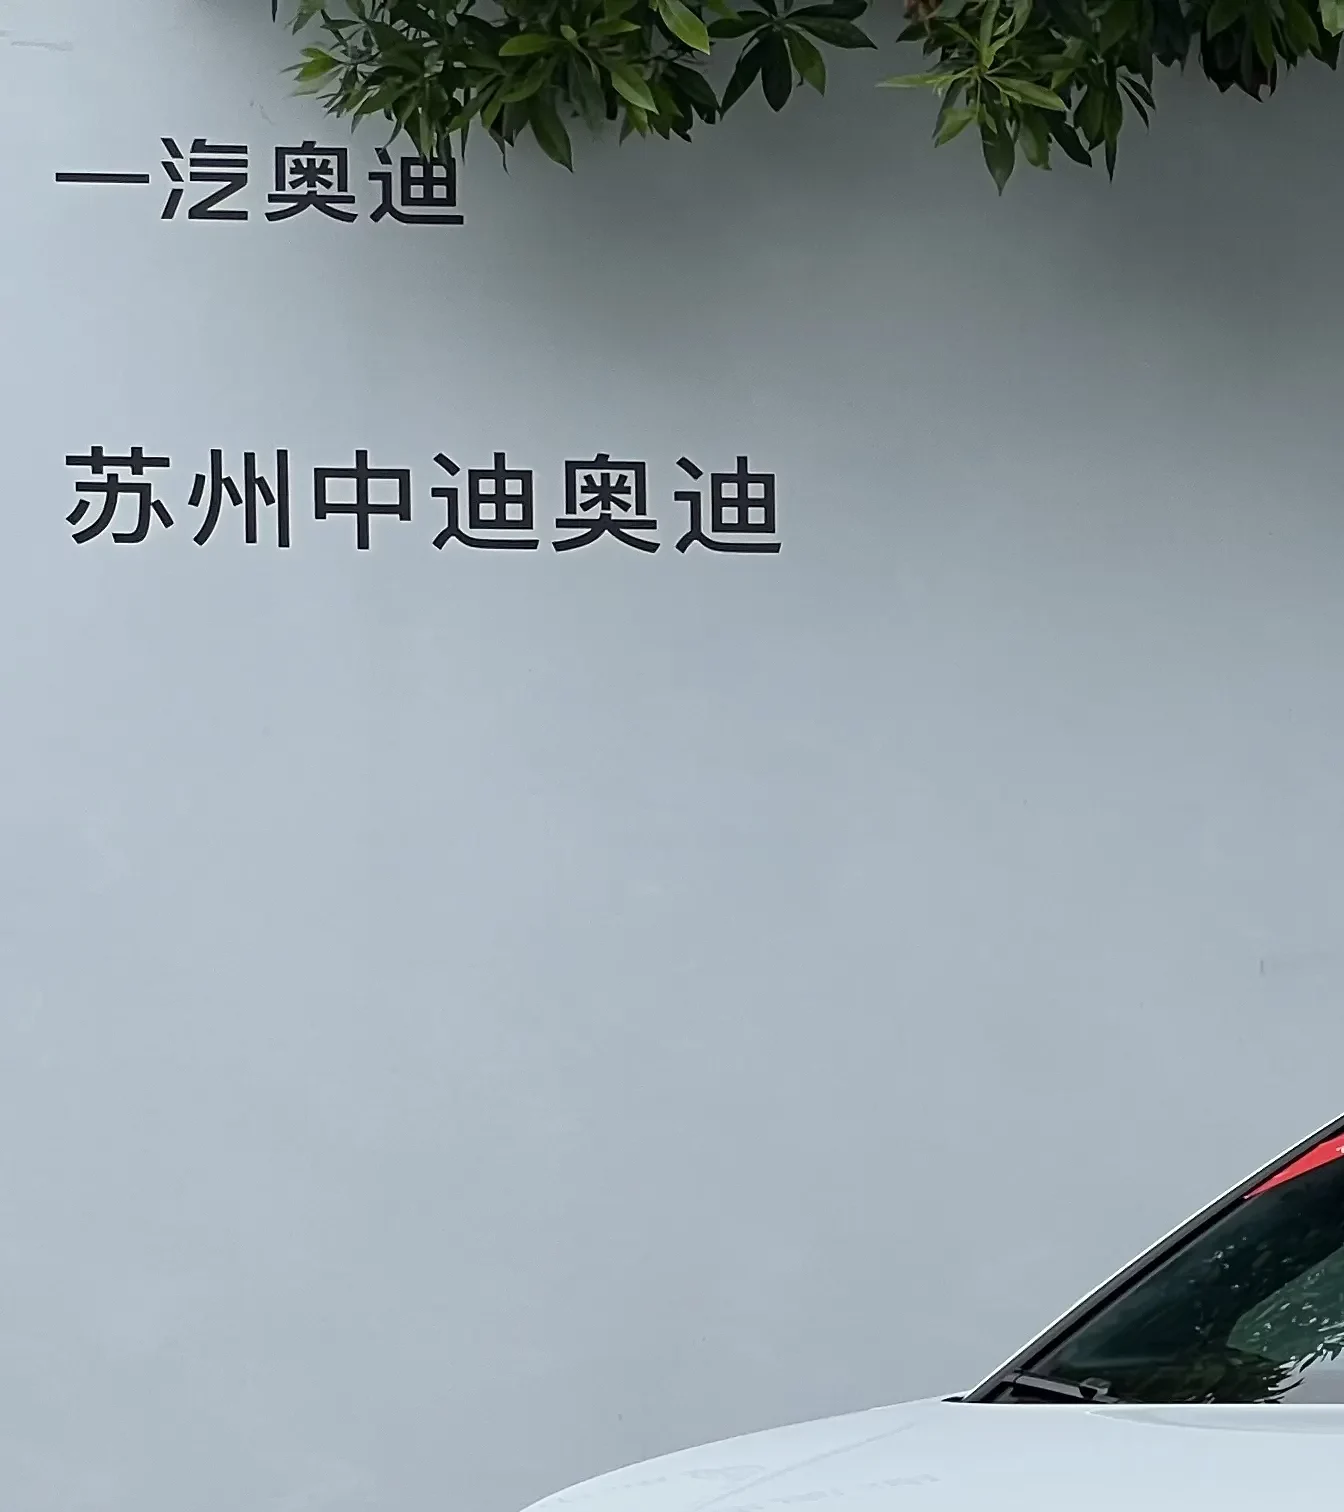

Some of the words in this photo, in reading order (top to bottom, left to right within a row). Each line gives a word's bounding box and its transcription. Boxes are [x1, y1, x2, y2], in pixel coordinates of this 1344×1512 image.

[55, 137, 465, 225] 一汽奥迪
[65, 445, 782, 554] 苏州中迪奥迪
